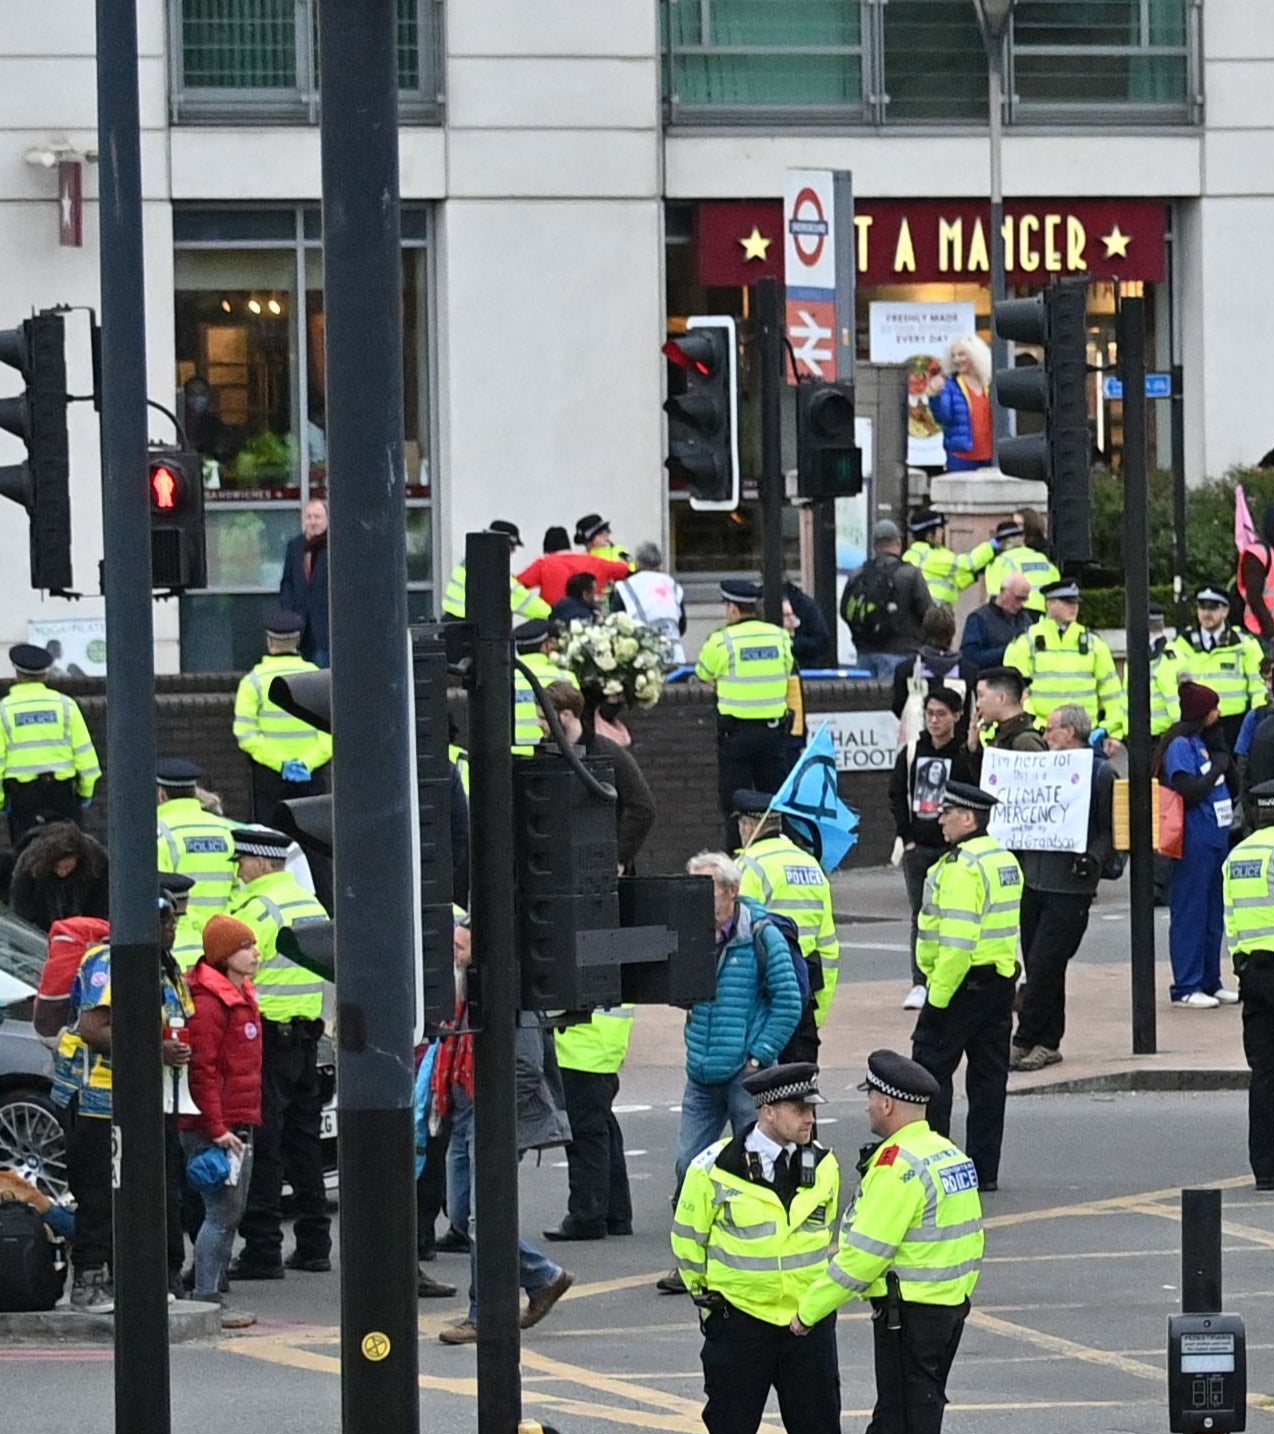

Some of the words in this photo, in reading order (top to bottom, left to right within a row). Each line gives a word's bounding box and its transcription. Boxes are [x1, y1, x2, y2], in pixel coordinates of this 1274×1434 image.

[894, 216, 917, 272] A
[885, 312, 928, 323] FRESHLY
[929, 312, 958, 323] MADE
[895, 335, 926, 344] EVERY
[928, 335, 949, 344] DAY
[830, 729, 878, 747] HALL
[1014, 754, 1047, 769] here
[997, 785, 1062, 805] CLIMATE
[993, 803, 1070, 824] MERGENCY
[786, 871, 822, 885] POLICE
